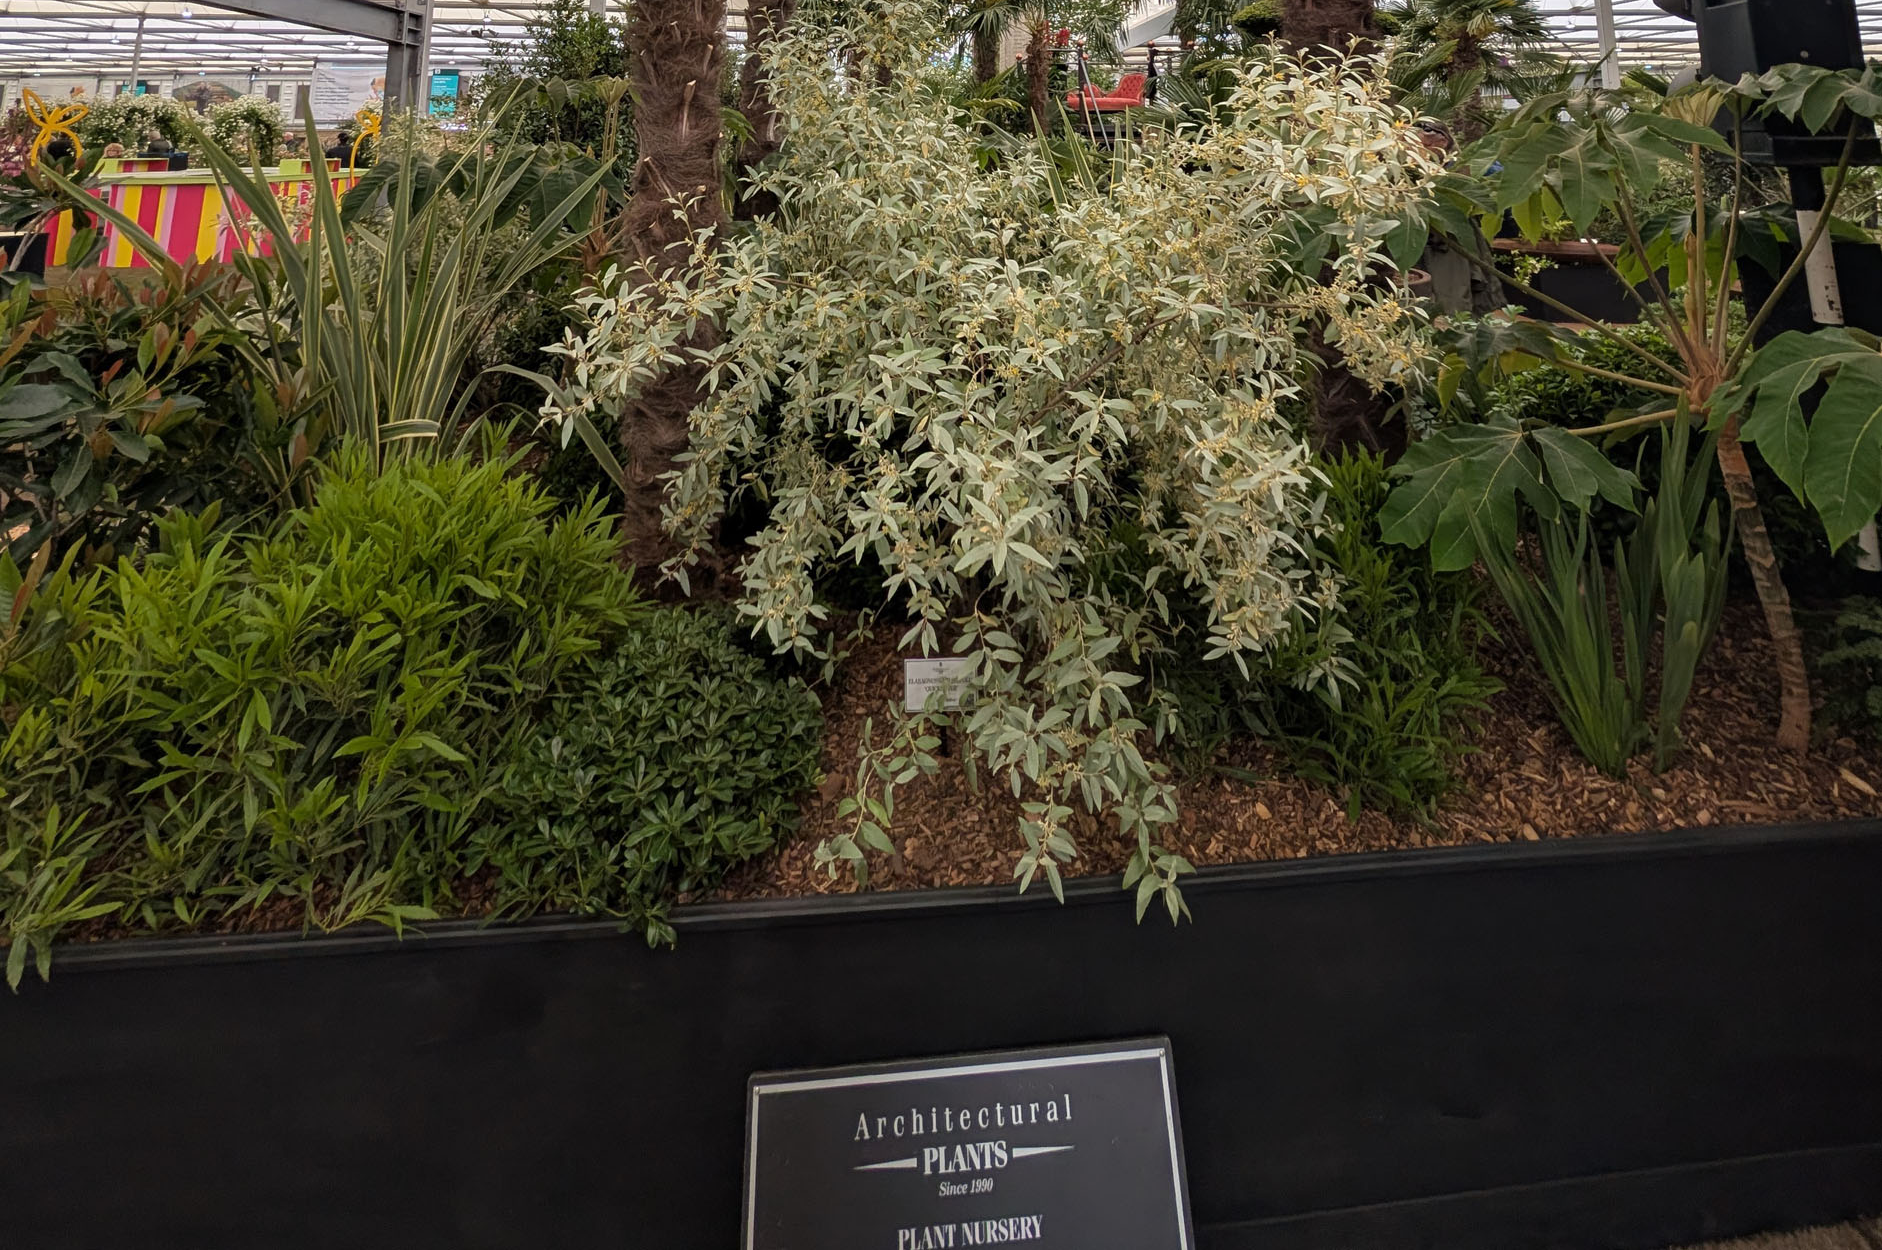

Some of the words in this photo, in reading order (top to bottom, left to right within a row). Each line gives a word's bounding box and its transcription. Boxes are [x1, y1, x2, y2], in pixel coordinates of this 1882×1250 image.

[854, 1094, 1072, 1141] Architectural
[923, 1140, 1008, 1175] PLANTS
[939, 1181, 967, 1196] Since
[970, 1177, 994, 1193] 1990
[897, 1224, 957, 1250] PLANT
[961, 1214, 1043, 1246] NURSERY
